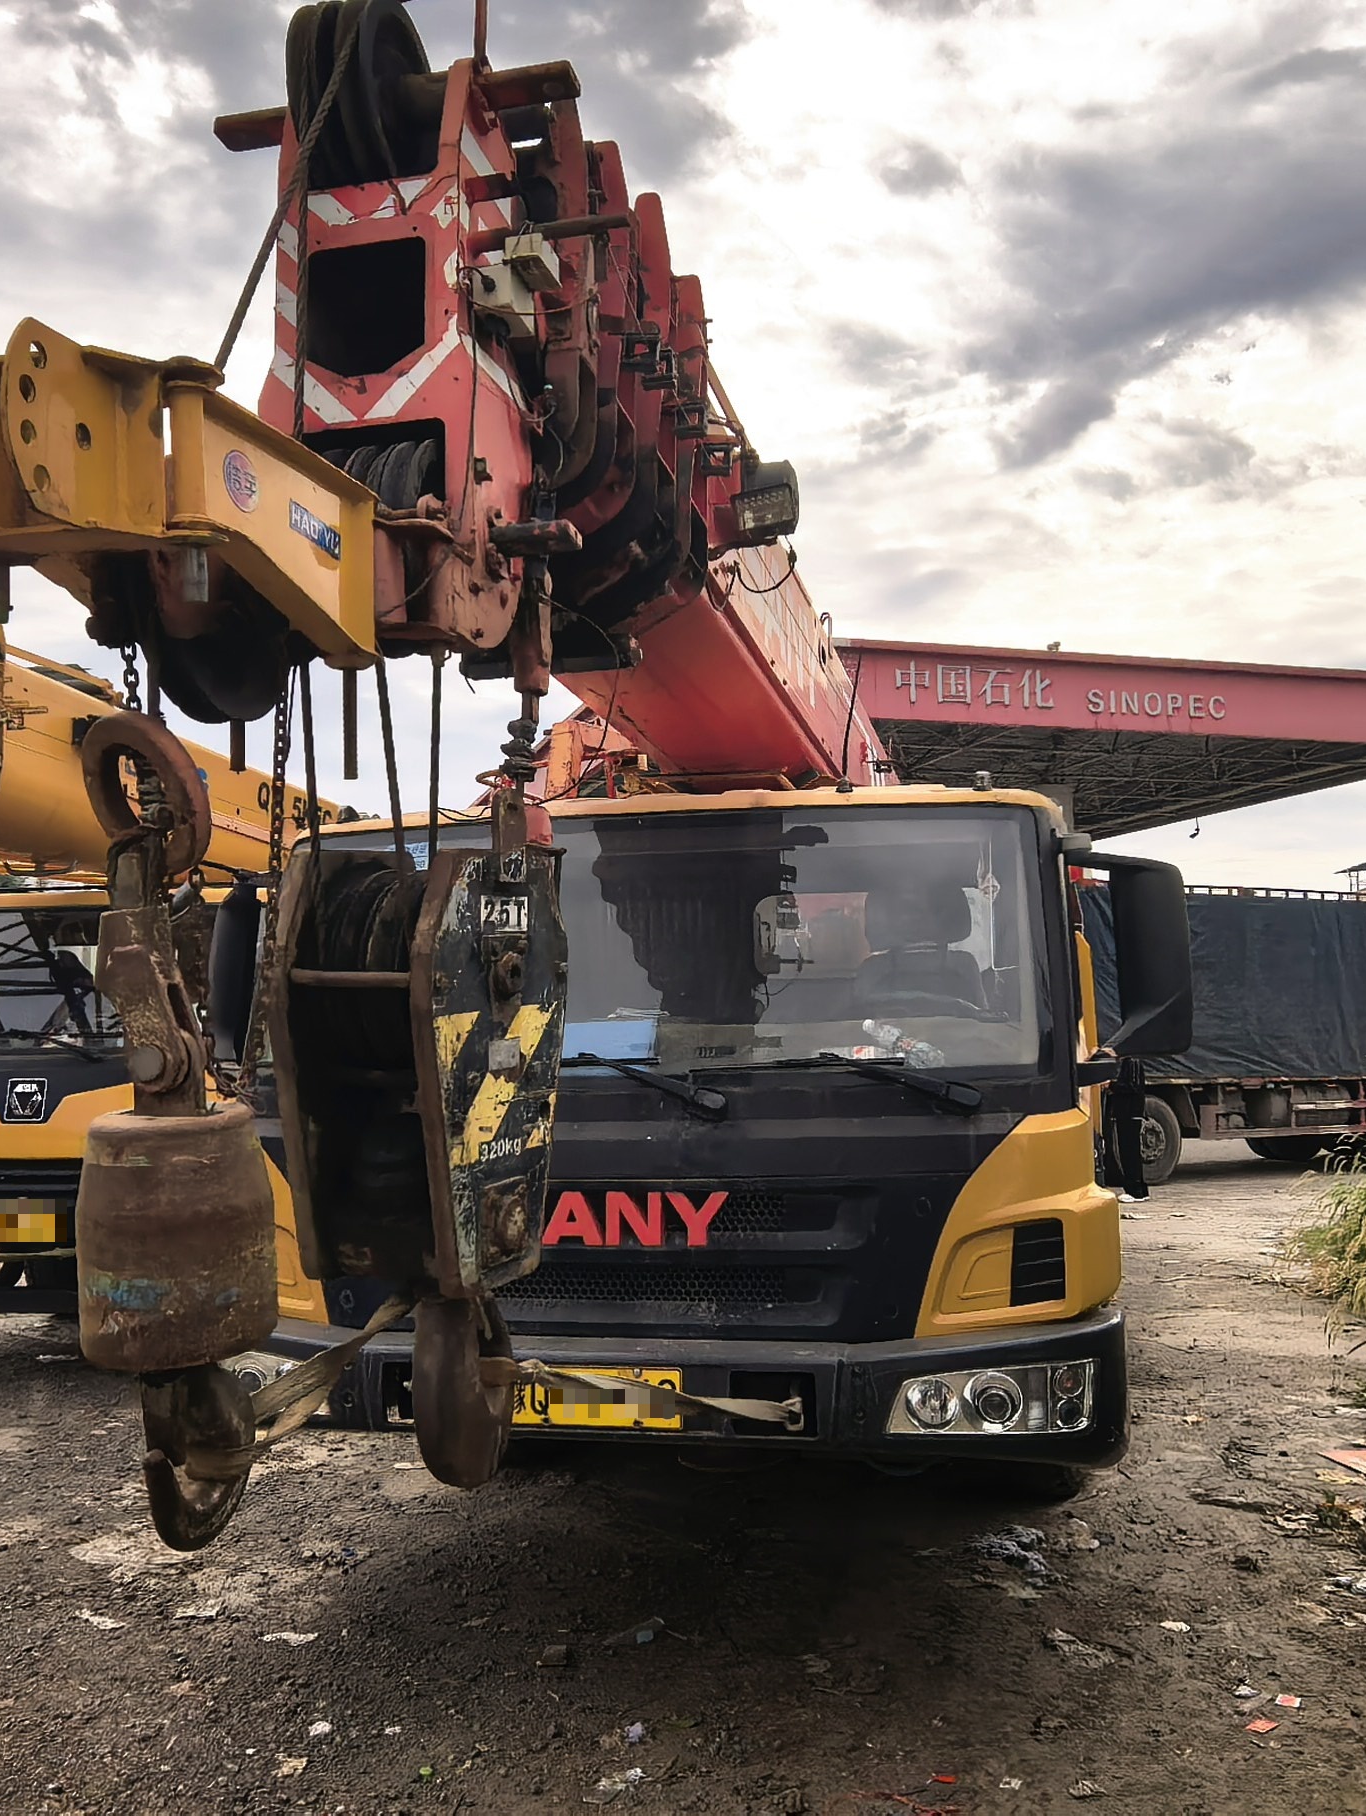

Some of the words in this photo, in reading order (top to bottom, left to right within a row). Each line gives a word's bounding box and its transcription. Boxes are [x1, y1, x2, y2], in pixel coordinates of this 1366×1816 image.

[895, 660, 1055, 708] 中国石化
[1086, 688, 1227, 720] SINOPEC
[484, 899, 527, 927] 25T
[480, 1138, 522, 1162] 320kg
[542, 1191, 729, 1246] ANY
